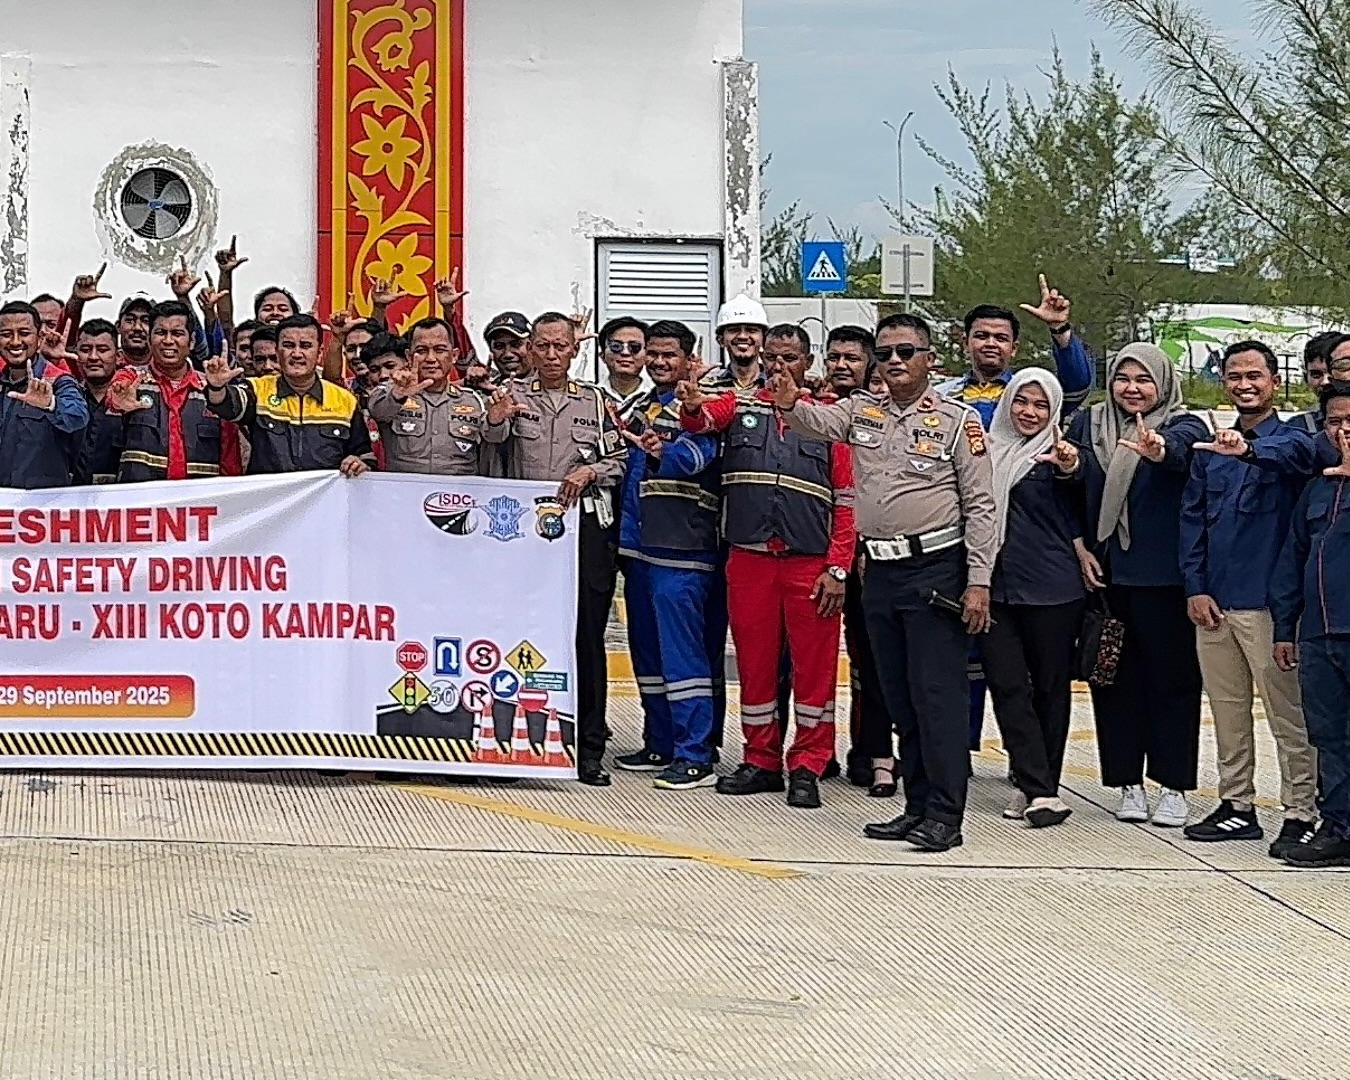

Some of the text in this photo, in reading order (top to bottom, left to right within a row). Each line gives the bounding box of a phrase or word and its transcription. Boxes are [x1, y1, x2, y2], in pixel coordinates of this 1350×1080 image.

[13, 557, 135, 593] SAFETY
[149, 556, 287, 593] DRIVING
[92, 603, 147, 640] XIII
[160, 603, 251, 640] KOTO
[263, 602, 396, 642] KAMPAR
[400, 651, 425, 663] STOP
[23, 686, 122, 710] September
[126, 686, 170, 706] 2025
